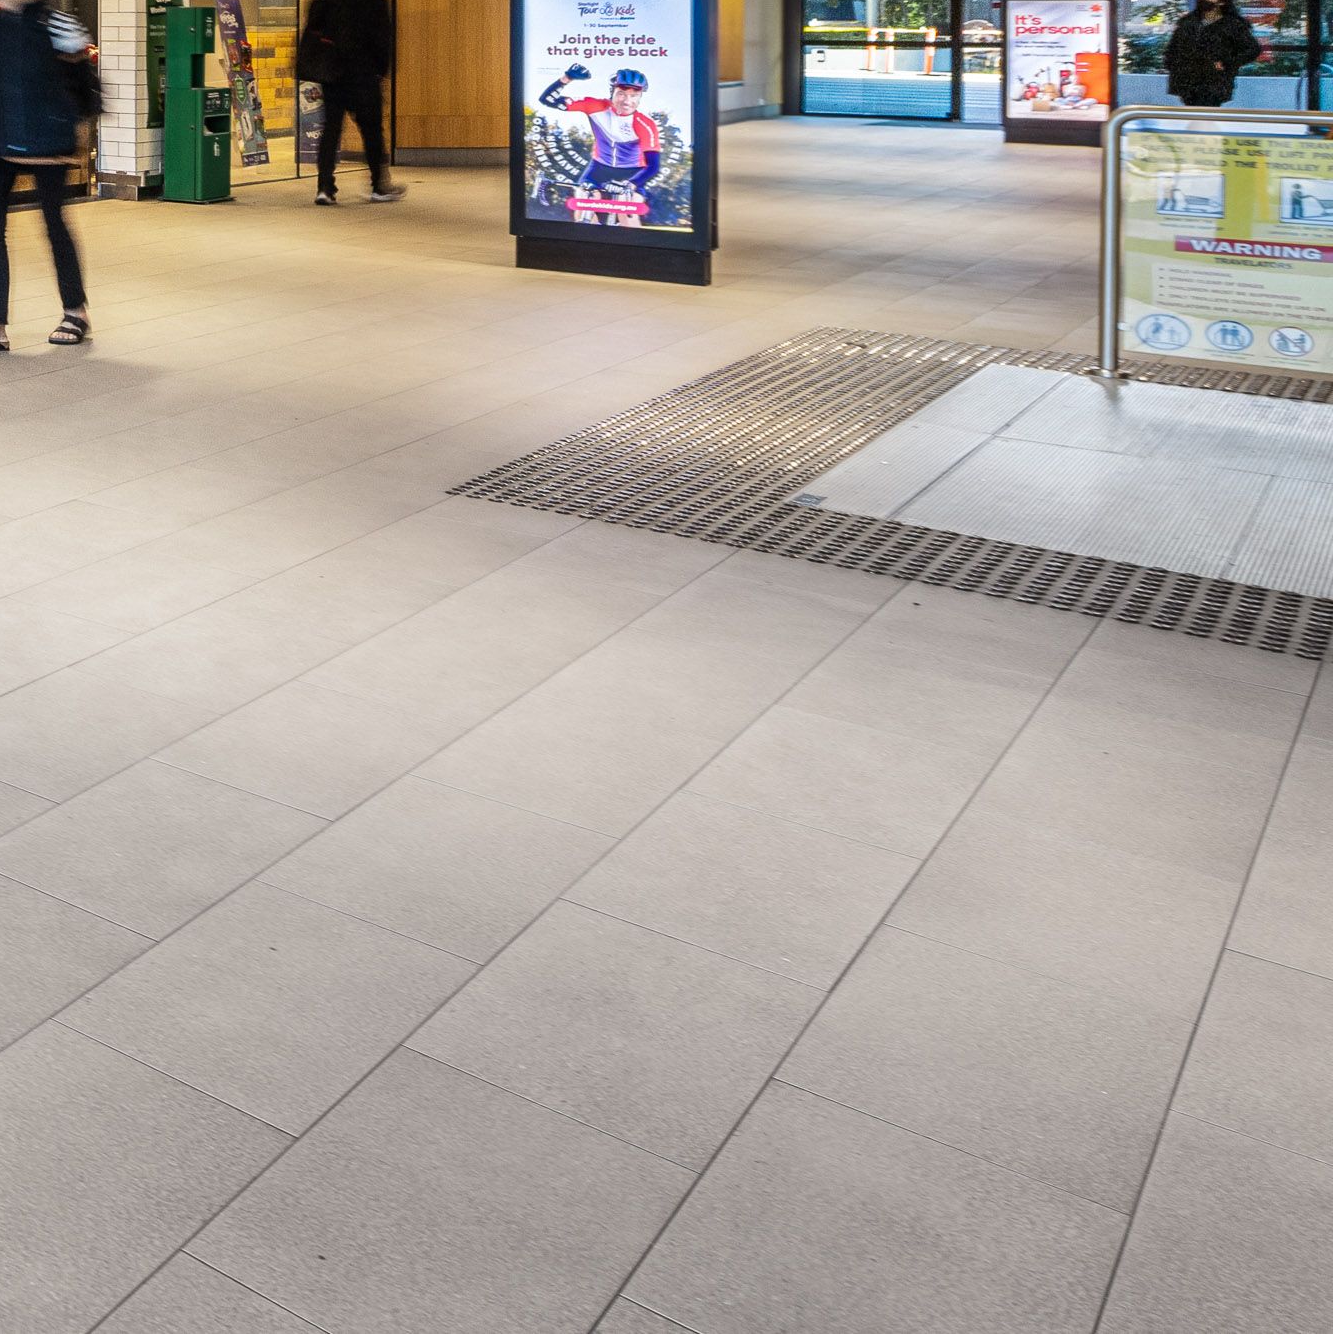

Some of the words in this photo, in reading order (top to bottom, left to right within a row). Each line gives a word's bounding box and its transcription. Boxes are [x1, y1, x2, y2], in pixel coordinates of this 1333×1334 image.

[578, 6, 599, 16] Tour
[615, 4, 635, 16] Kids
[1015, 15, 1041, 25] It's
[1015, 24, 1100, 36] personal
[559, 34, 591, 44] Join
[595, 34, 620, 45] the
[624, 34, 656, 45] ride
[547, 46, 579, 56] that
[584, 46, 624, 58] gives
[629, 47, 668, 57] back
[1189, 240, 1322, 260] WARNING
[1214, 257, 1293, 269] TRAVELATORS
